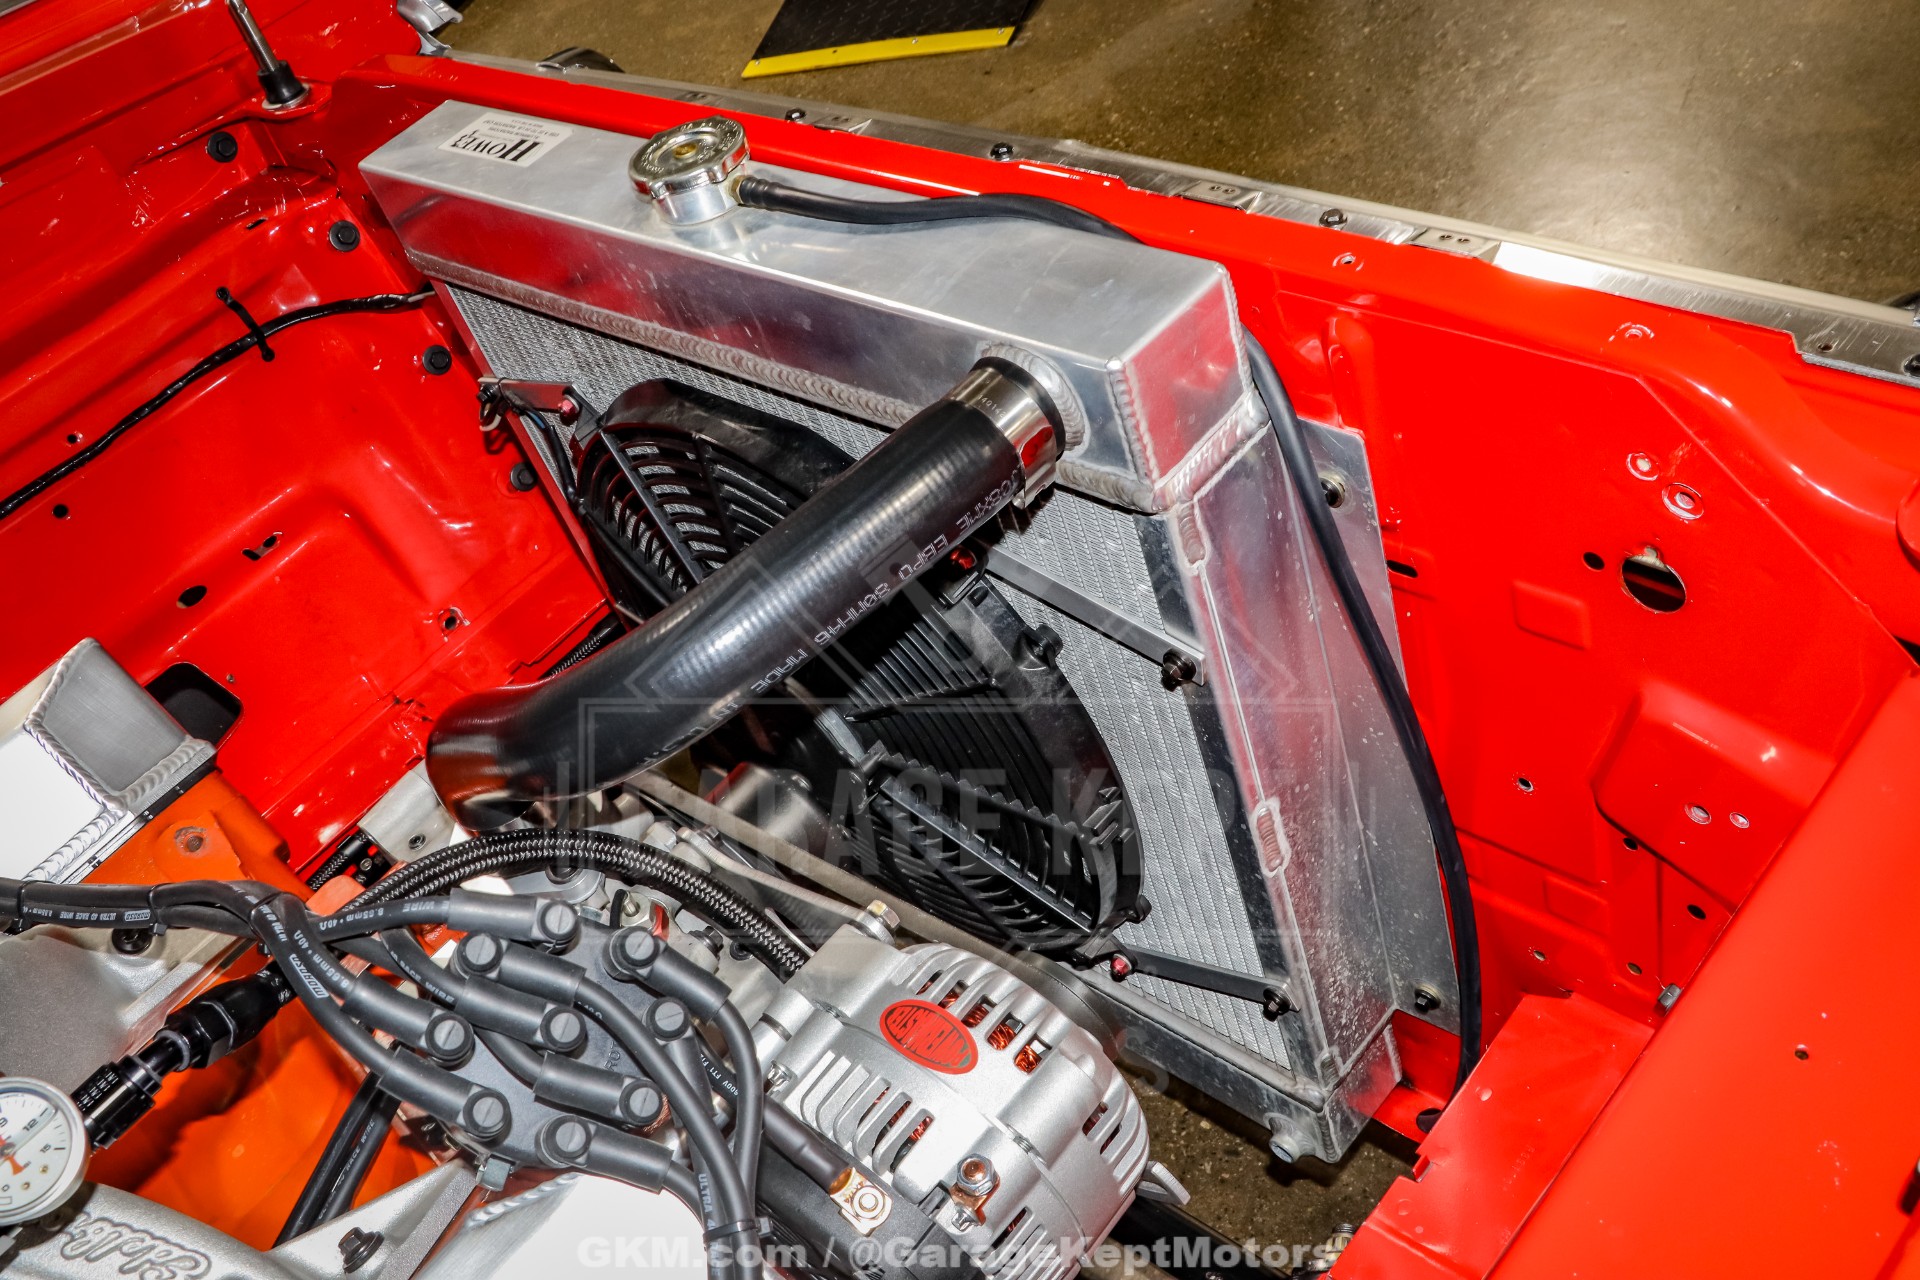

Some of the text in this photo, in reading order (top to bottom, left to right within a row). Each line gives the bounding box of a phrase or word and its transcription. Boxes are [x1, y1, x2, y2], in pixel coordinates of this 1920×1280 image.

[750, 648, 809, 694] MADE
[711, 701, 739, 721] IN
[402, 900, 435, 913] WIRE
[60, 910, 75, 920] WIRE
[75, 911, 90, 920] RACE
[100, 911, 117, 922] ULTRA
[346, 907, 384, 922] 8.65mm
[313, 952, 350, 989] 8.65mm
[425, 980, 456, 1003] WIRE
[708, 1066, 722, 1081] FT1
[22, 1118, 39, 1132] 12
[360, 1118, 376, 1144] WIRE
[40, 1144, 52, 1154] 15
[698, 1173, 713, 1213] ULTRA
